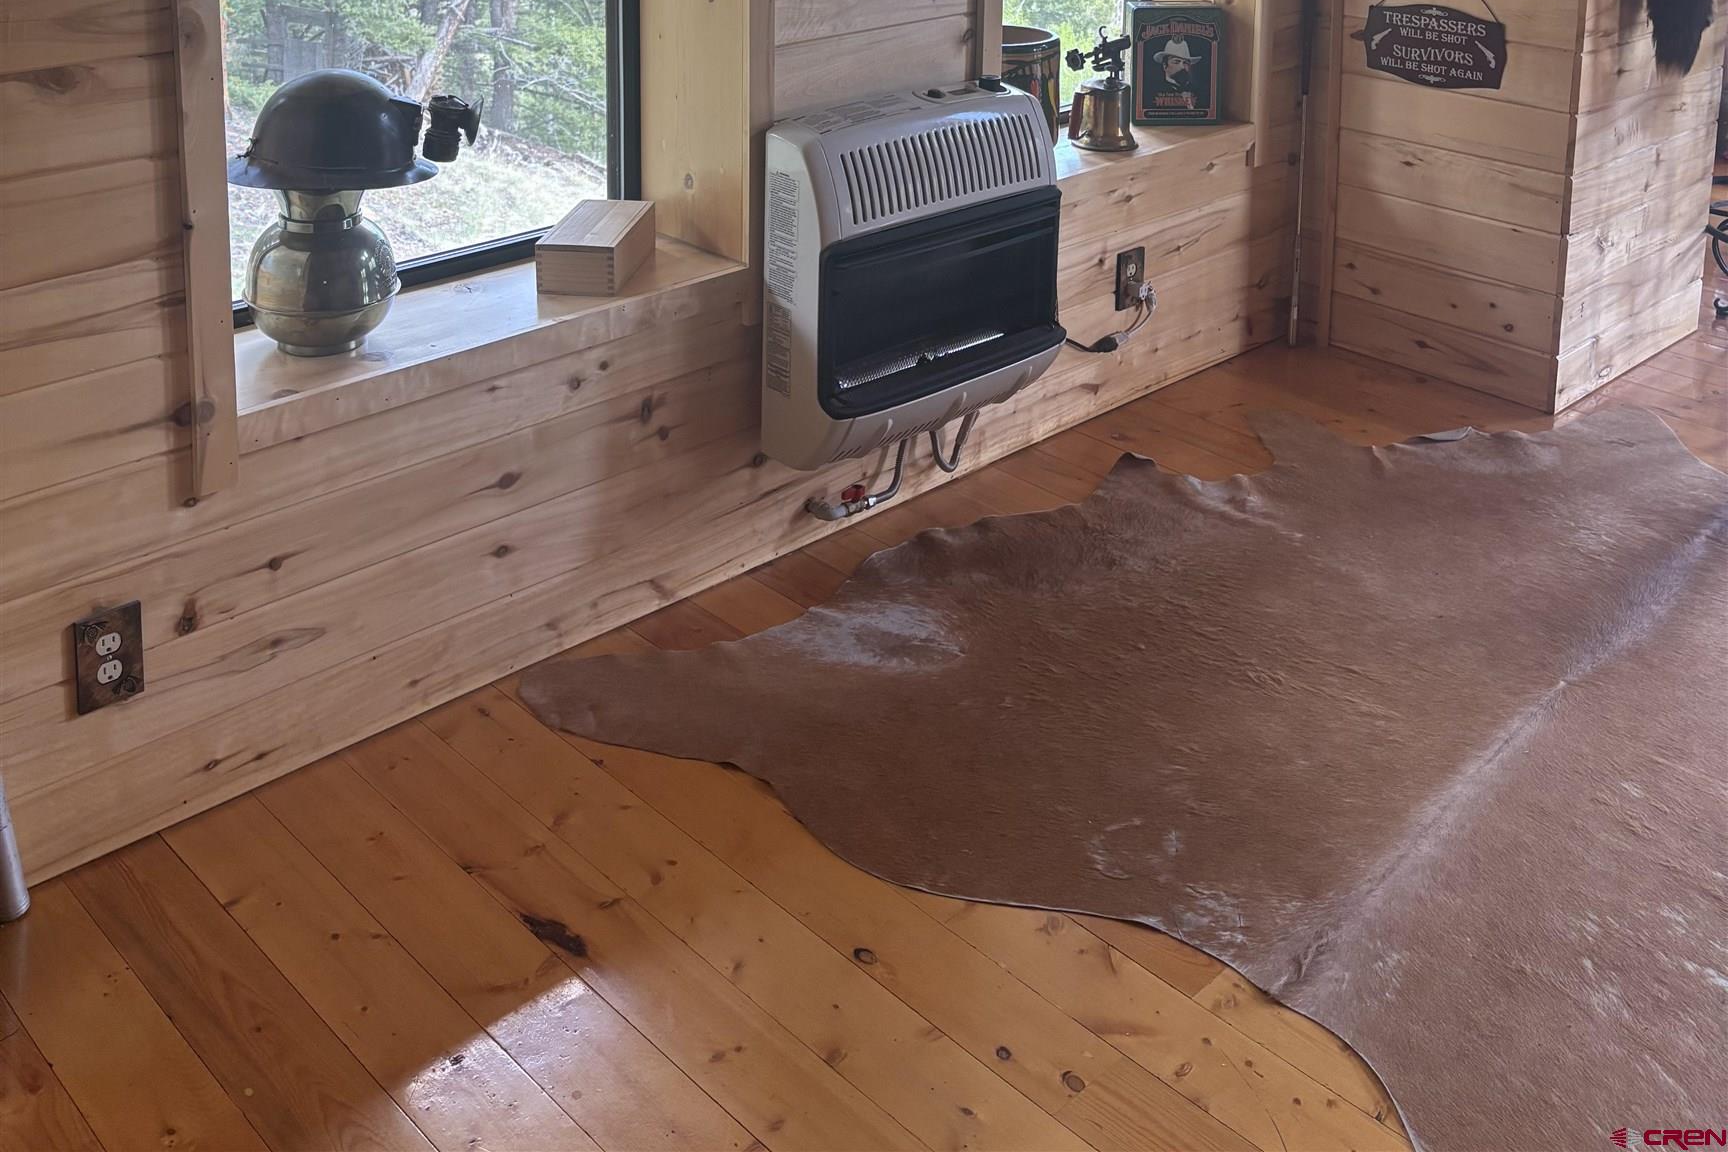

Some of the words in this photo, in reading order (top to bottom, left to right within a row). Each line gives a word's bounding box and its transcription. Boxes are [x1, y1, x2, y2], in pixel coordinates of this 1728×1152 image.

[1383, 11, 1487, 38] TRESPASSERS
[1400, 26, 1424, 40] WILL
[1425, 31, 1439, 42] BE
[1441, 33, 1468, 46] SHOT
[1393, 44, 1474, 67] SURVIVORS
[1380, 56, 1404, 69] WILL
[1405, 60, 1420, 72] BE
[1421, 63, 1447, 76] SHOT
[1449, 68, 1484, 82] AGAIN
